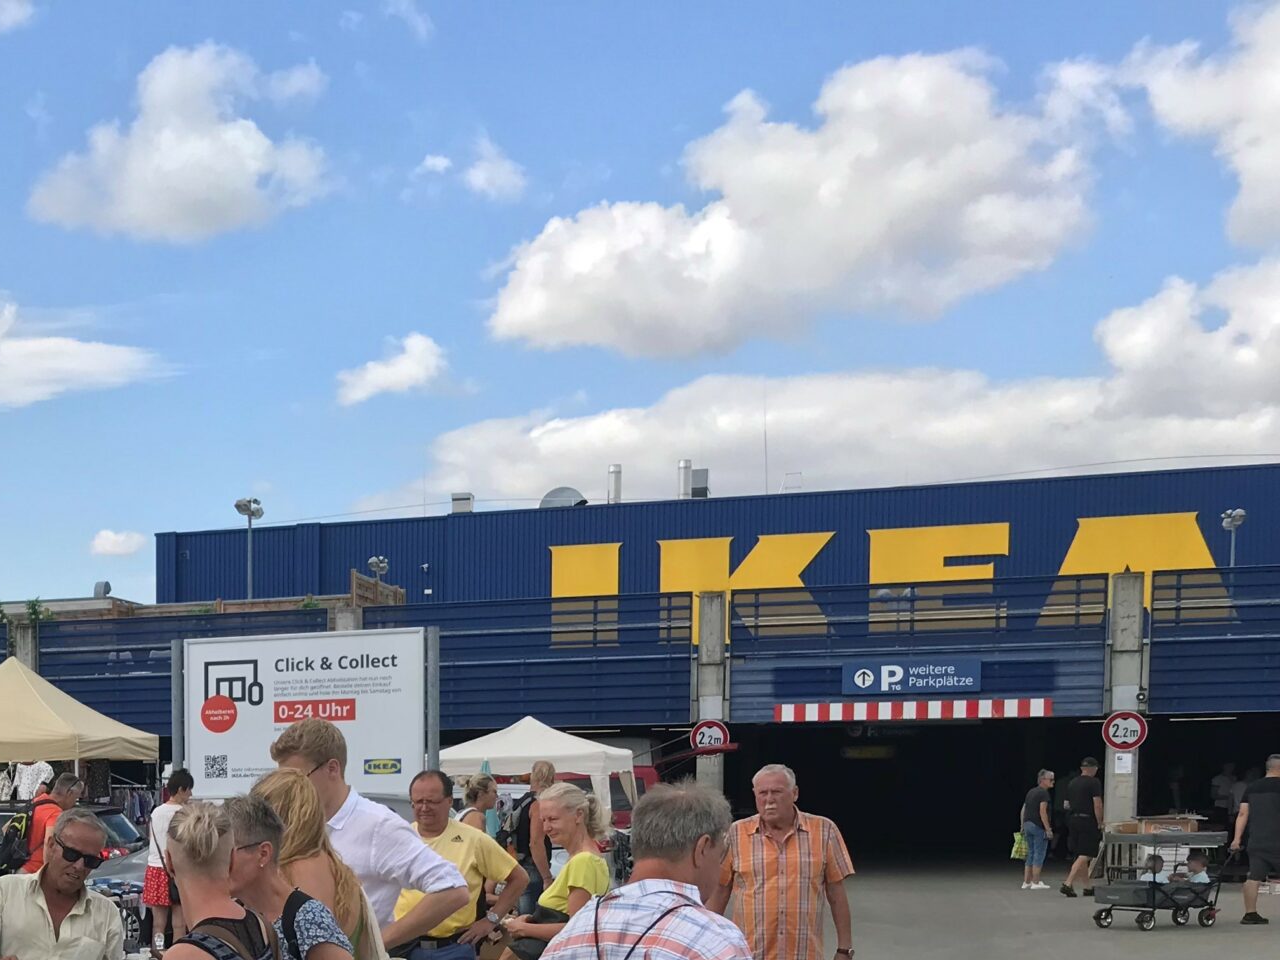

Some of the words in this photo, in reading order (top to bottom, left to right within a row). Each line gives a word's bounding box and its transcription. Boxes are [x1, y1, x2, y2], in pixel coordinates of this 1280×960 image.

[549, 511, 1242, 648] IKEA
[274, 657, 315, 673] Click
[320, 656, 333, 671] &
[338, 653, 398, 670] Collect
[909, 665, 956, 675] weitere
[880, 665, 904, 691] P
[908, 676, 974, 688] Parkplätze
[278, 704, 314, 719] 0-24
[318, 702, 351, 717] Uhr
